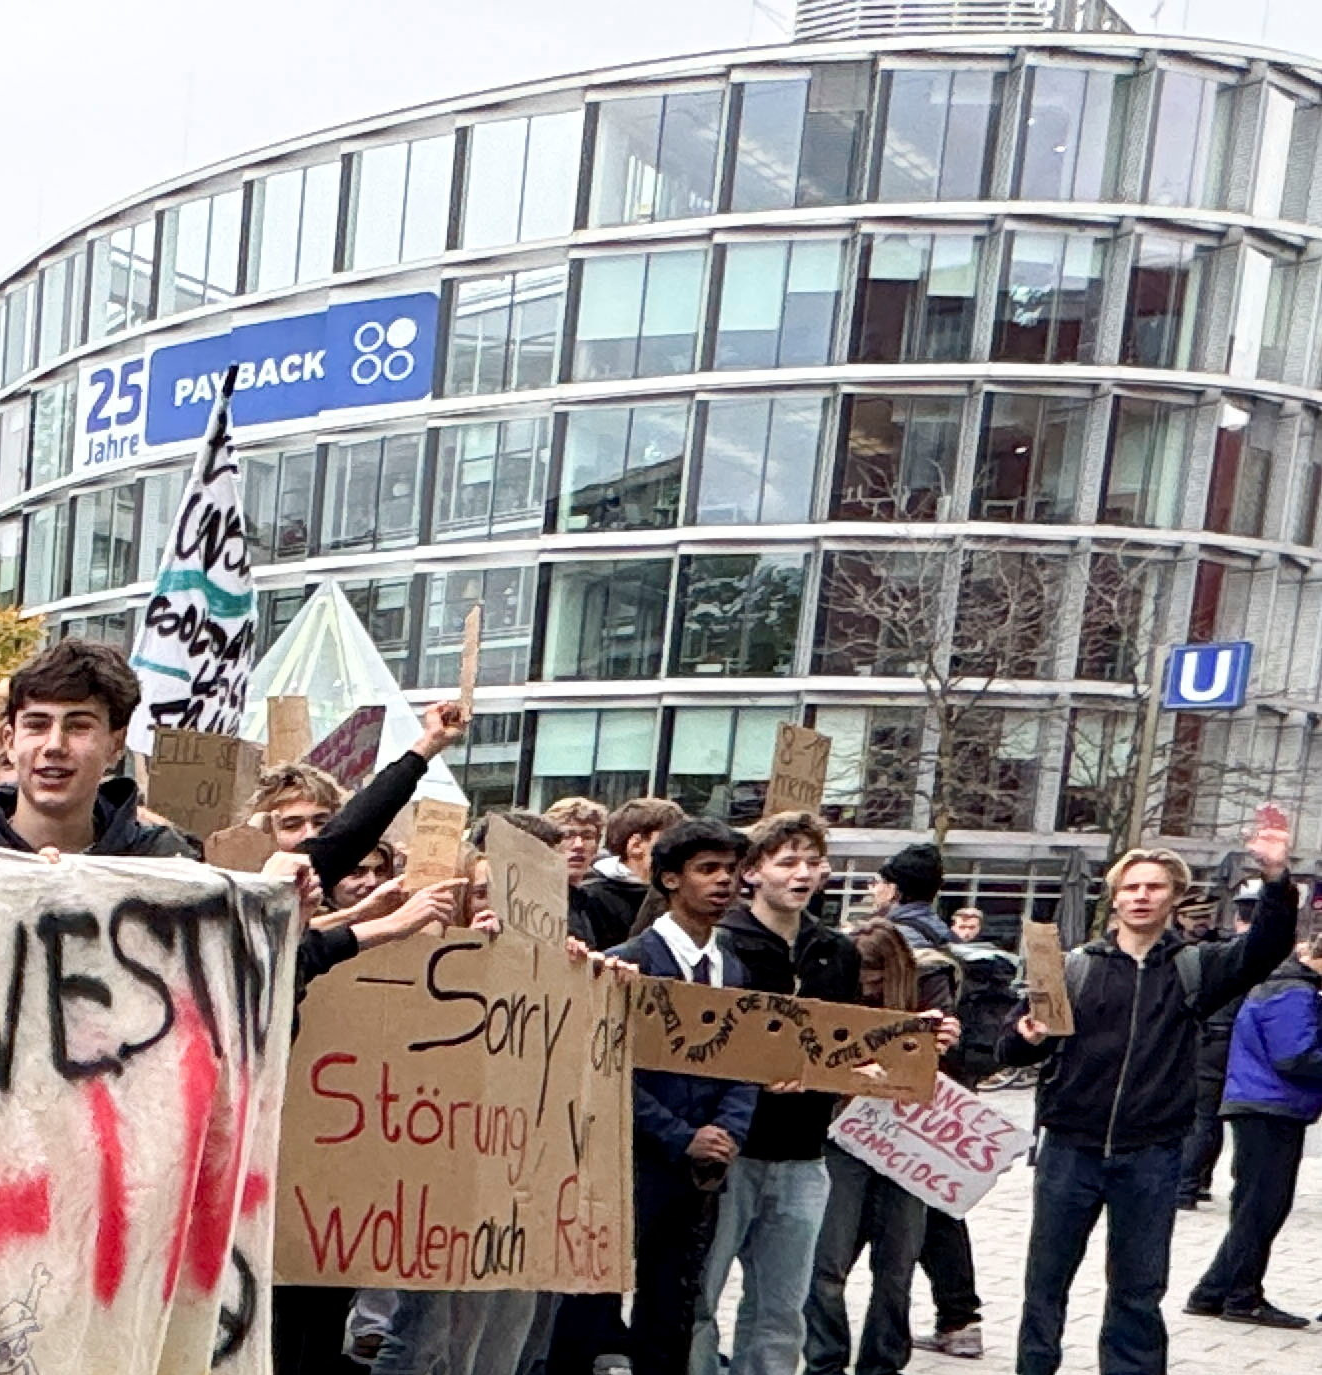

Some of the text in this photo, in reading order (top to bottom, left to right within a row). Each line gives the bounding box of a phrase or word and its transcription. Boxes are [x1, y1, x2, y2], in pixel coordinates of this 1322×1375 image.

[86, 357, 144, 433] 25
[174, 349, 326, 407] PAYBACK
[83, 430, 140, 467] Jahre
[1179, 651, 1232, 702] U
[409, 942, 571, 1128] Sorry
[295, 1180, 469, 1283] Wollen
